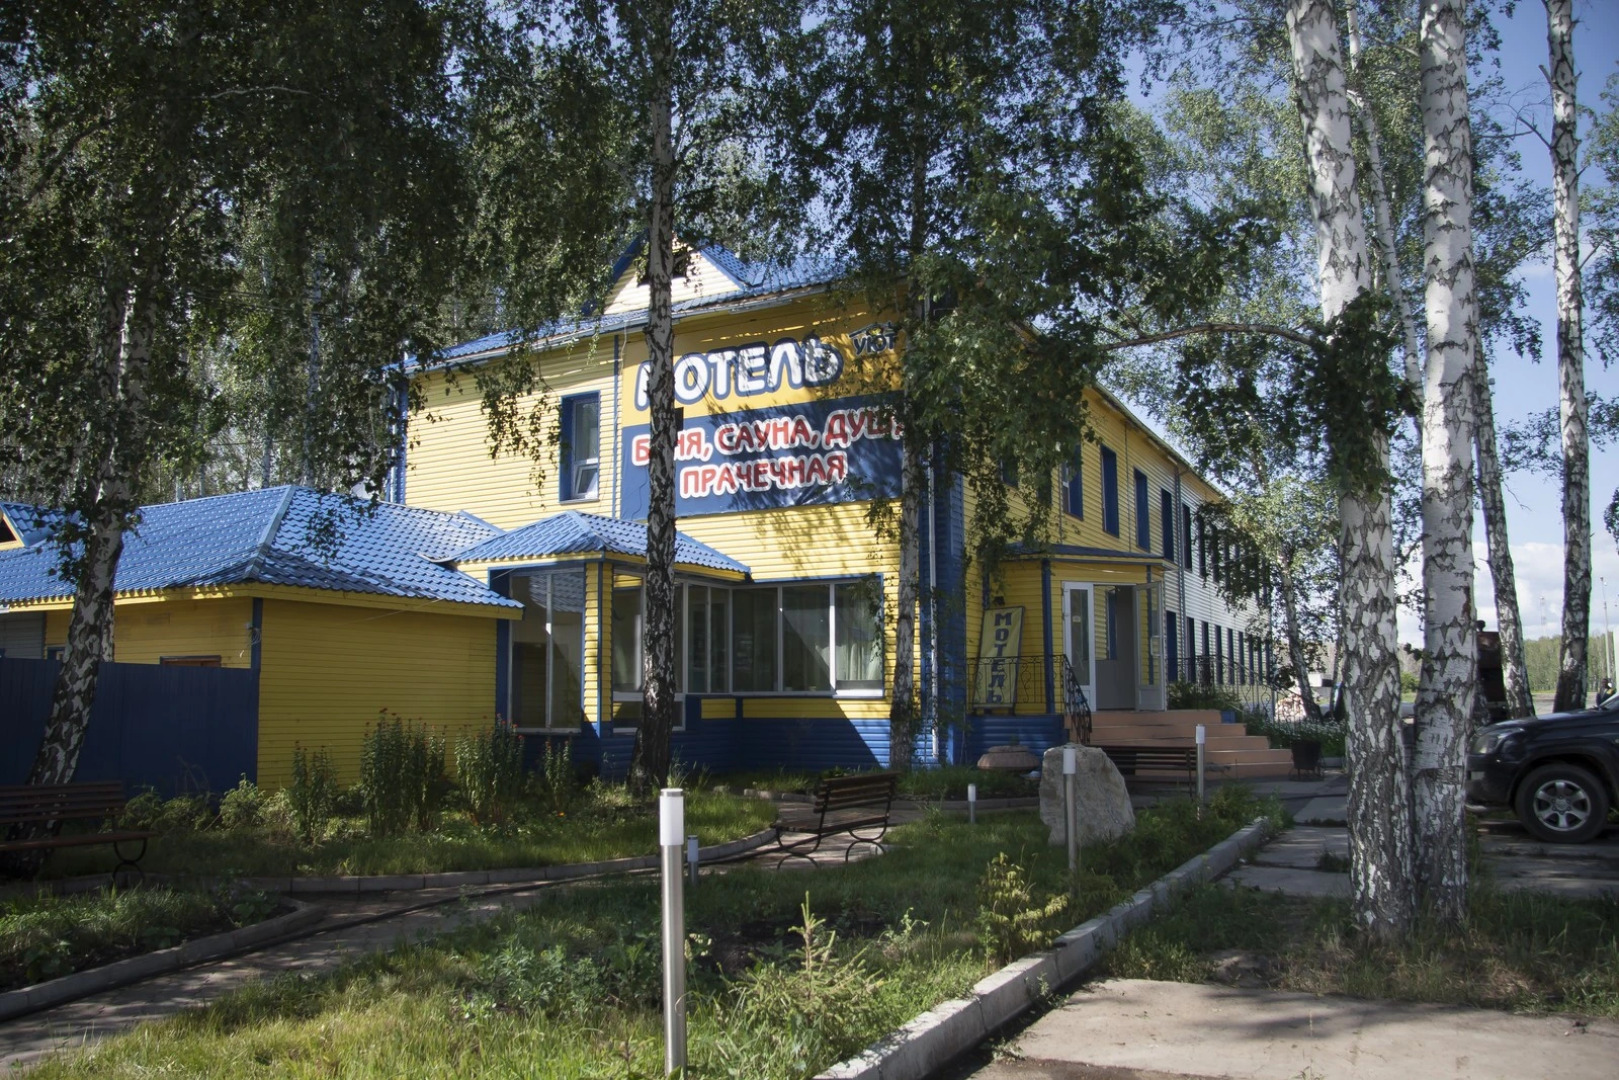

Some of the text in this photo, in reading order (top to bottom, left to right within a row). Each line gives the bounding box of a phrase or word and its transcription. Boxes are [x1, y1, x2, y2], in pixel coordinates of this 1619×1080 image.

[853, 331, 896, 355] УЮТ
[633, 428, 712, 465] БНЯ,
[716, 416, 820, 455] САУНА,
[681, 452, 848, 498] ПРАЧЕЧНАЯ
[986, 612, 1012, 704] МОТЕЛЬ
